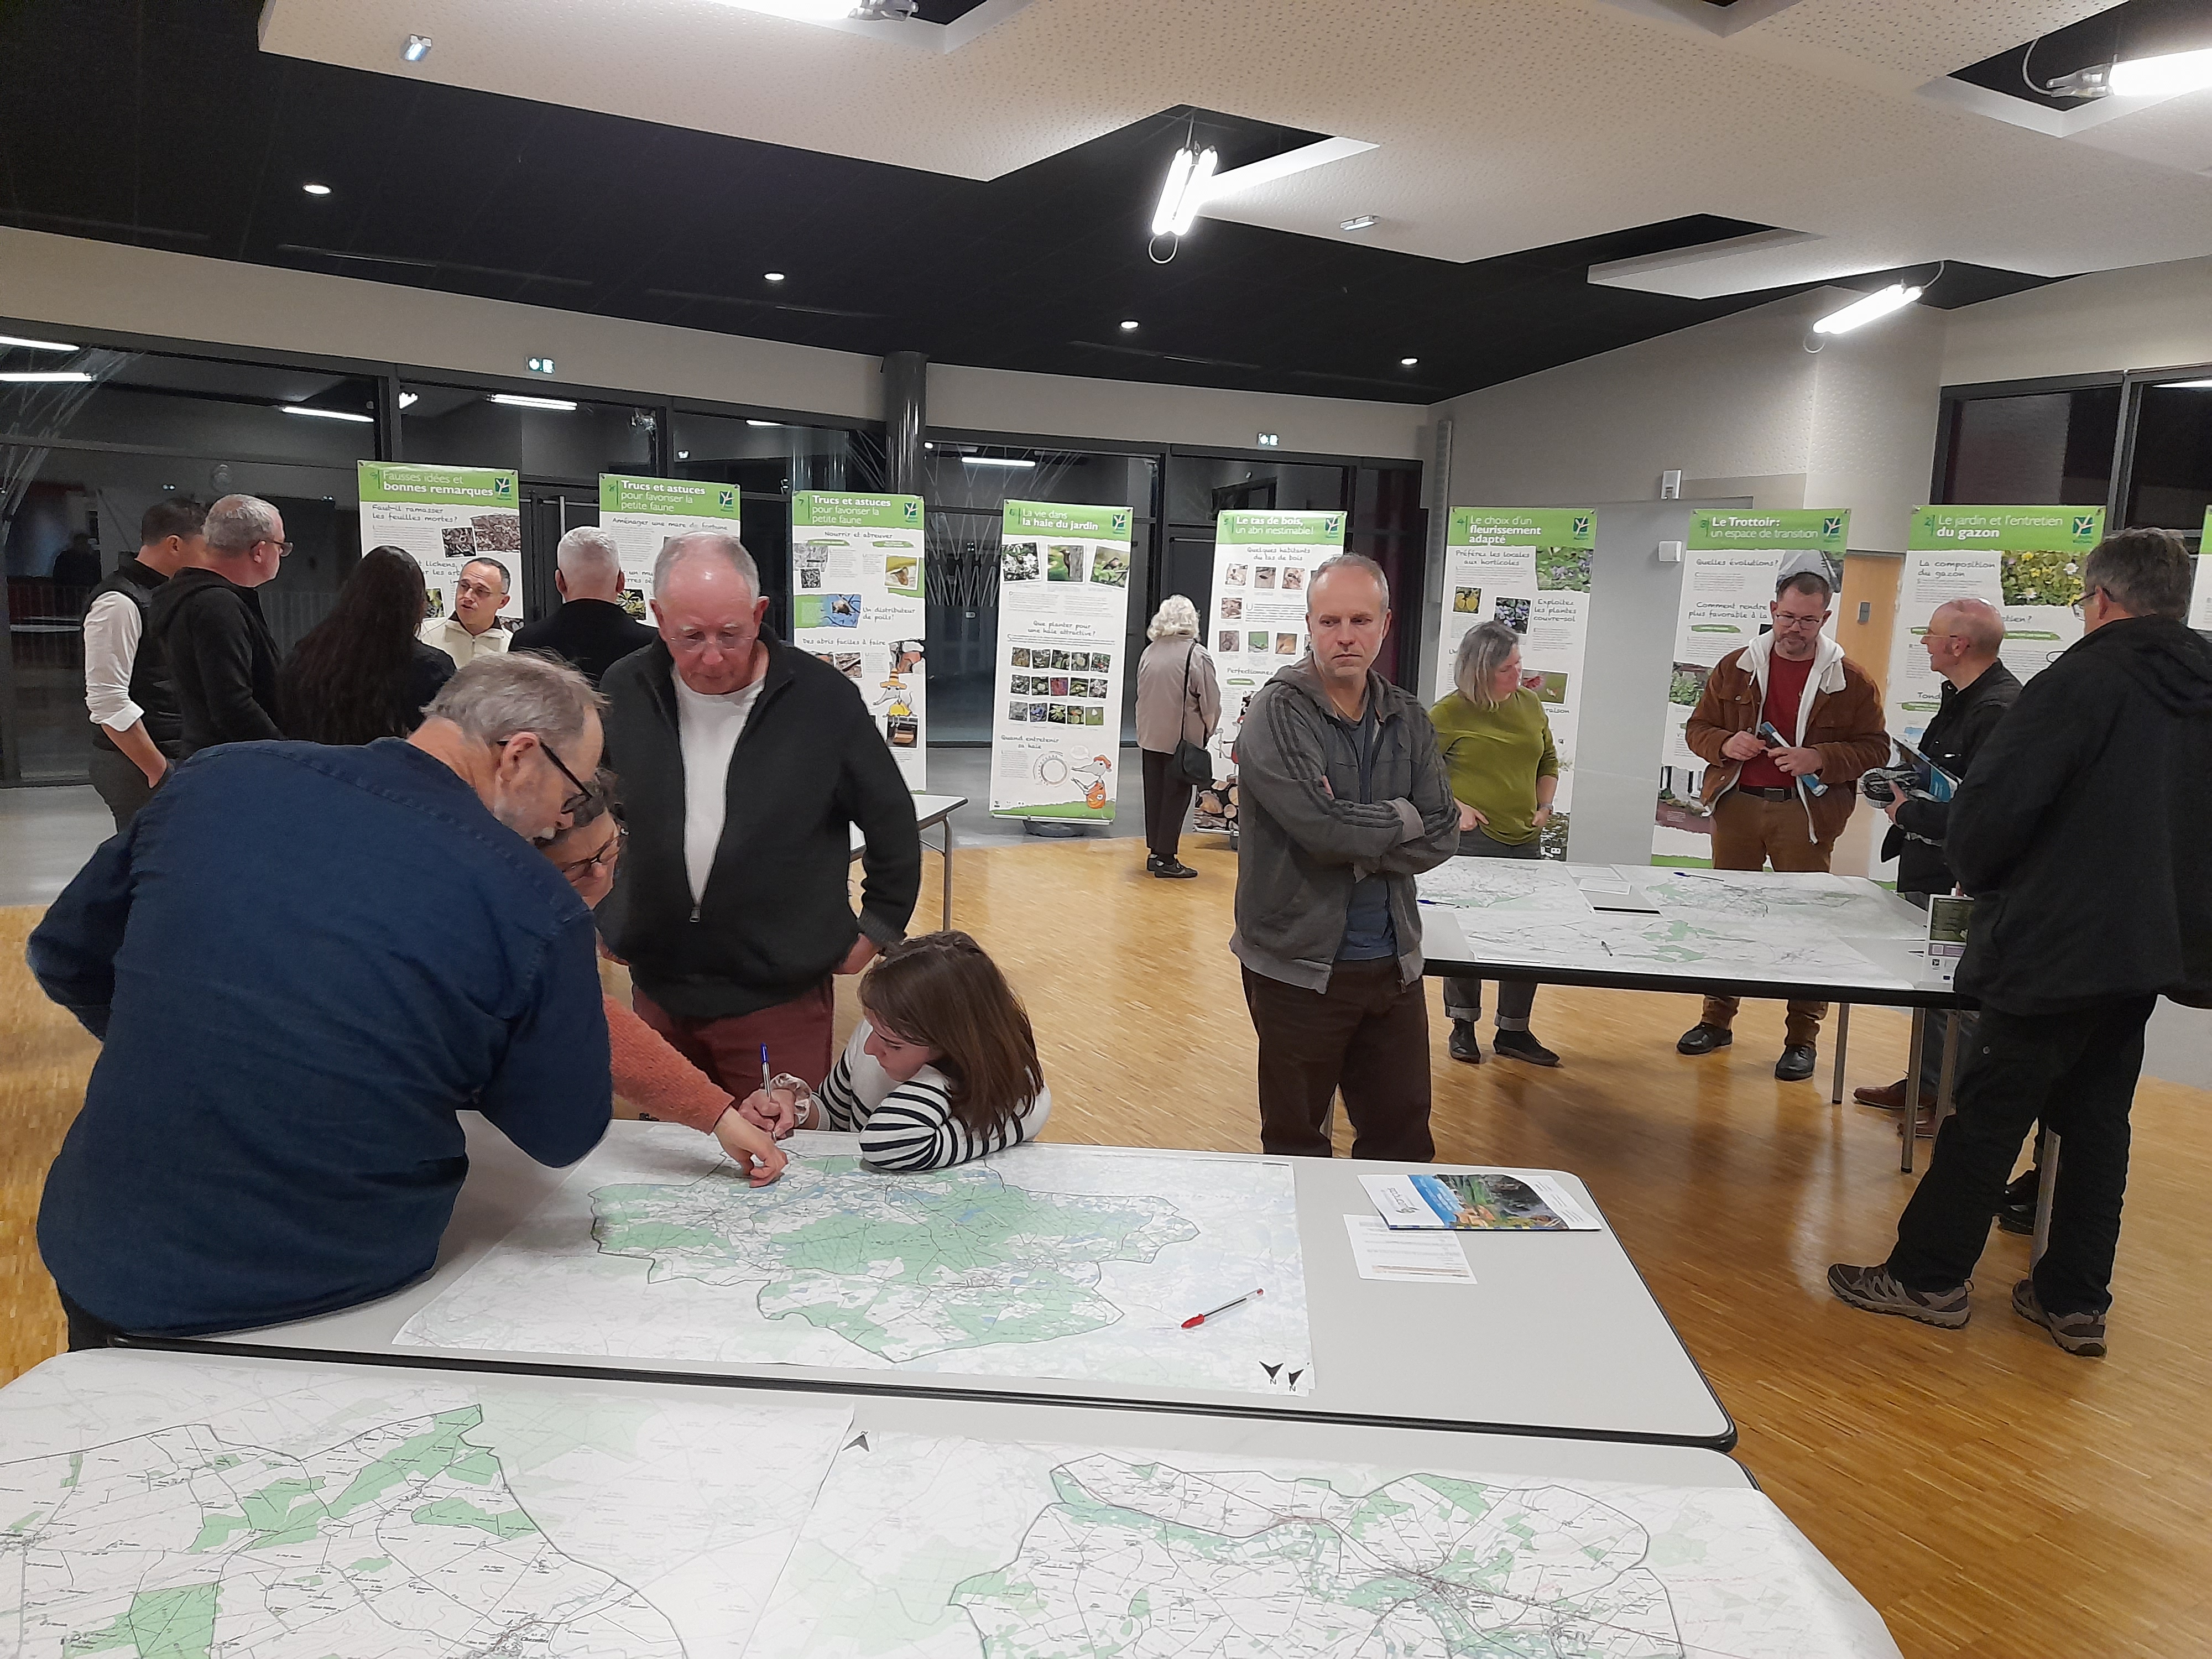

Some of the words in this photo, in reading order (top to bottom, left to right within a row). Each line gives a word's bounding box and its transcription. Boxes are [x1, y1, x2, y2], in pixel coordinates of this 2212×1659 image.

[383, 470, 421, 482] Fausses
[424, 472, 450, 484] idées
[453, 476, 464, 484] et
[384, 481, 427, 492] bonnes
[430, 486, 494, 498] remarques
[621, 479, 650, 491] Trucs
[653, 482, 664, 491] et
[667, 485, 705, 494] astuces
[621, 492, 643, 500] pour
[646, 492, 683, 503] favoriser
[686, 495, 693, 503] la
[812, 495, 839, 504] Trucs
[842, 497, 852, 505] et
[855, 498, 891, 507] astuces
[621, 501, 647, 510] petite
[650, 502, 674, 512] faune
[812, 506, 833, 515] pour
[835, 505, 870, 515] favoriser
[872, 507, 880, 515] la
[389, 513, 421, 521] feuilles
[1022, 508, 1032, 517] La
[1048, 510, 1067, 519] dans
[612, 517, 649, 526] Aménager
[812, 515, 836, 524] petite
[839, 515, 862, 524] faune
[1022, 518, 1031, 526] la
[1034, 518, 1053, 528] haie
[1056, 520, 1068, 528] du
[1070, 521, 1099, 531] jardin
[1237, 516, 1248, 525] Le
[1267, 516, 1279, 525] de
[1281, 517, 1303, 526] bois,
[1470, 515, 1481, 525] Le
[1484, 515, 1510, 525] choix
[1512, 515, 1532, 525] d'un
[1712, 517, 1726, 526] Le
[1925, 516, 1931, 526] 2
[1938, 515, 1952, 526] Le
[1955, 515, 1986, 528] jardin
[1990, 515, 2002, 525] et
[2005, 515, 2063, 526] l'entretien
[1248, 526, 1263, 534] abri
[1265, 526, 1313, 535] inestimable!
[1470, 525, 1542, 535] fleurissement
[1711, 530, 1723, 538] un
[1725, 530, 1757, 540] espace
[1759, 529, 1772, 538] de
[1775, 529, 1819, 539] transition
[1937, 528, 1954, 538] du
[1958, 529, 2000, 540] gazon
[1469, 535, 1506, 546] adapté
[1729, 558, 1779, 566] évolutions?
[1934, 560, 1995, 572] composition
[1538, 598, 1574, 608] Exploitez
[1696, 601, 1736, 609] Comment
[1548, 607, 1577, 616] plantes
[1688, 609, 1705, 619] plus
[1709, 609, 1747, 618] favorable
[1048, 621, 1073, 630] planter
[1025, 735, 1060, 743] entretenir
